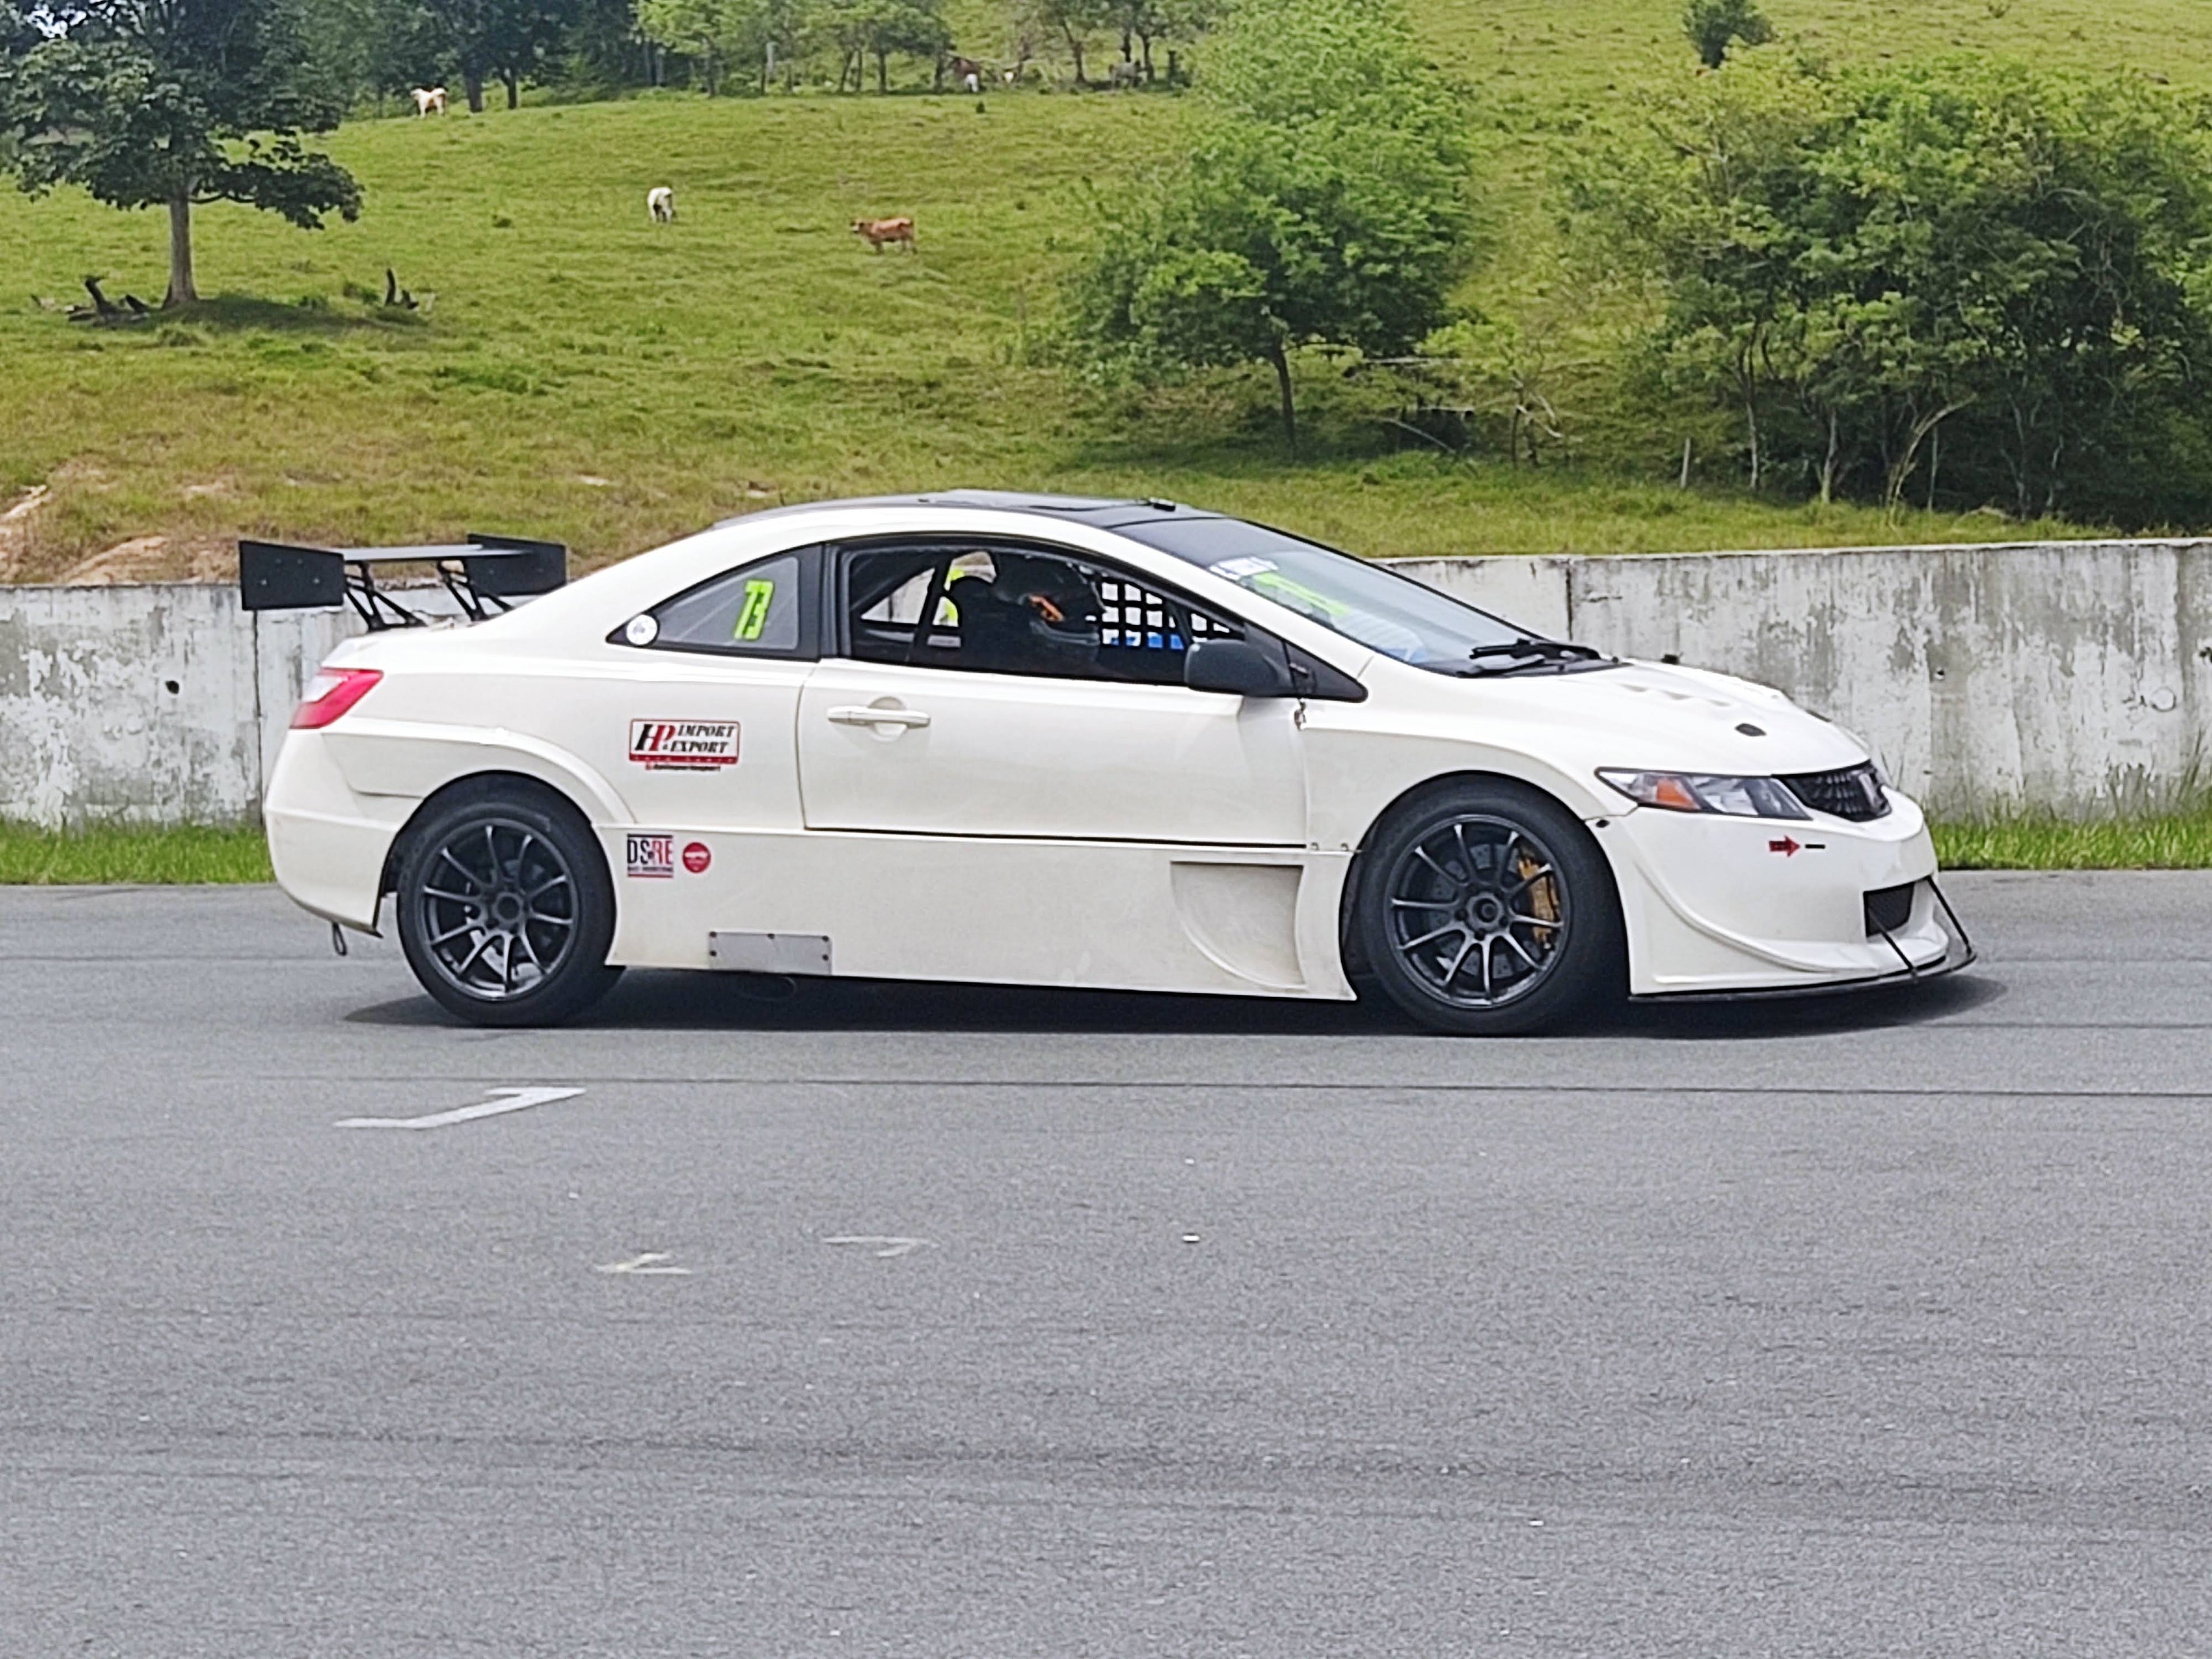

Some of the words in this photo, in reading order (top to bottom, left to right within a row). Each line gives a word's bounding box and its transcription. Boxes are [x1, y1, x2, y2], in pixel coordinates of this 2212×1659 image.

[734, 579, 774, 641] 13
[677, 725, 734, 737] IMPORT
[670, 740, 729, 753] EXPORT
